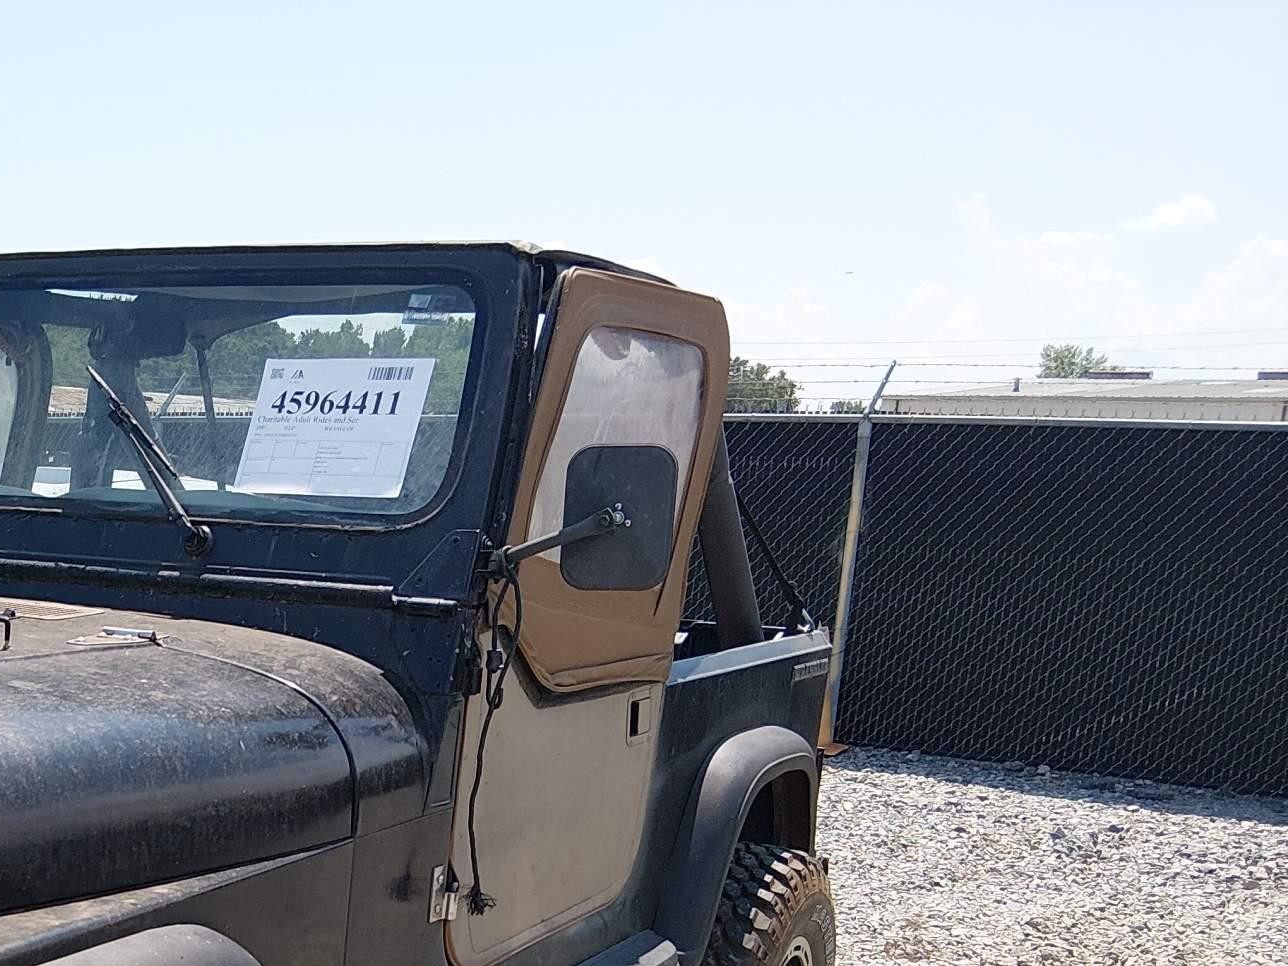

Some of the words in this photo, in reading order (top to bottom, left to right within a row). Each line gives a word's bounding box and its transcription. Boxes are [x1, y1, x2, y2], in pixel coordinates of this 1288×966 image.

[271, 389, 401, 416] 45964411
[257, 415, 291, 425] Charitable
[294, 415, 311, 424] Adult
[312, 415, 332, 424] Rides
[333, 415, 346, 424] and
